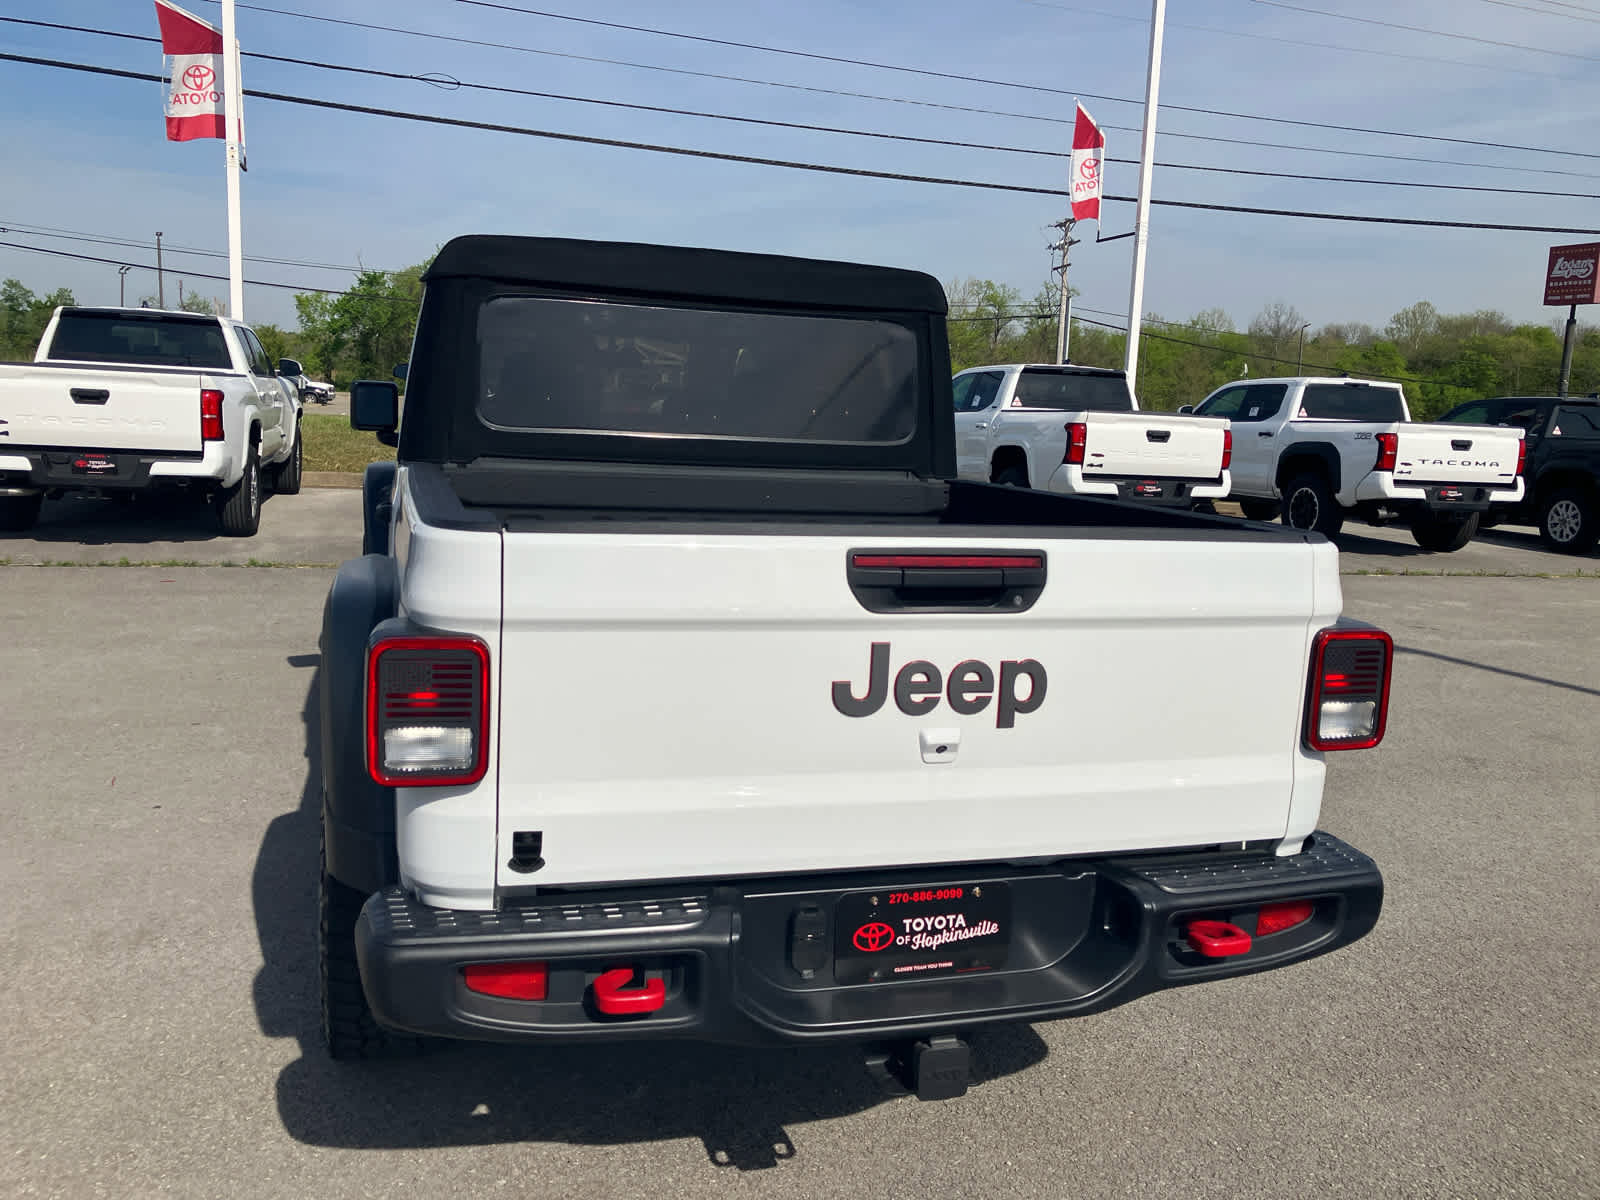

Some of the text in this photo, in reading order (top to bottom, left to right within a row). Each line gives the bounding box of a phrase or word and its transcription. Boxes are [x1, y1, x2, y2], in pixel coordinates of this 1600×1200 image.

[1417, 458, 1500, 468] TACOMA
[832, 641, 1048, 729] Jeep
[896, 920, 999, 950] OF Hopkinsville
[903, 914, 966, 933] TOYOTA
